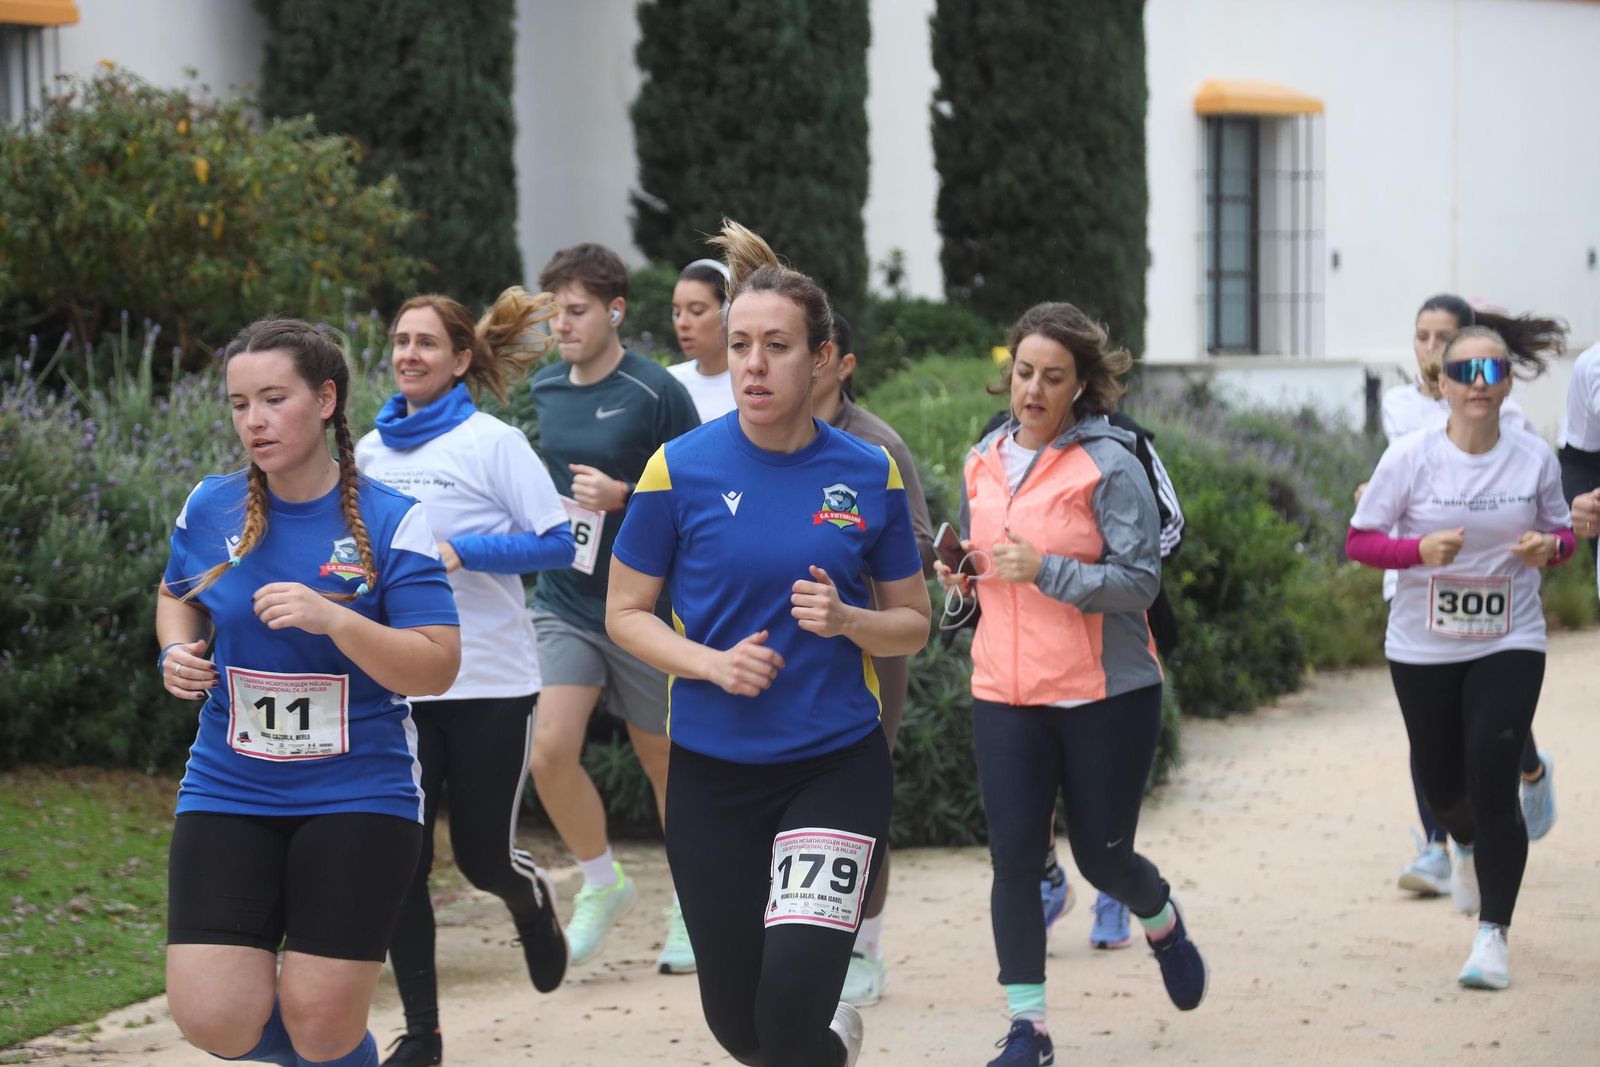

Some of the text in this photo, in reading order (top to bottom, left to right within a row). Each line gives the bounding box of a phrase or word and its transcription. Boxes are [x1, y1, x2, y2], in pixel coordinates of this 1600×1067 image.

[569, 518, 591, 546] 6
[1438, 589, 1505, 616] 300
[253, 696, 310, 731] 11
[840, 847, 857, 855] MUJER
[777, 853, 859, 895] 179
[828, 896, 843, 904] ISABEL
